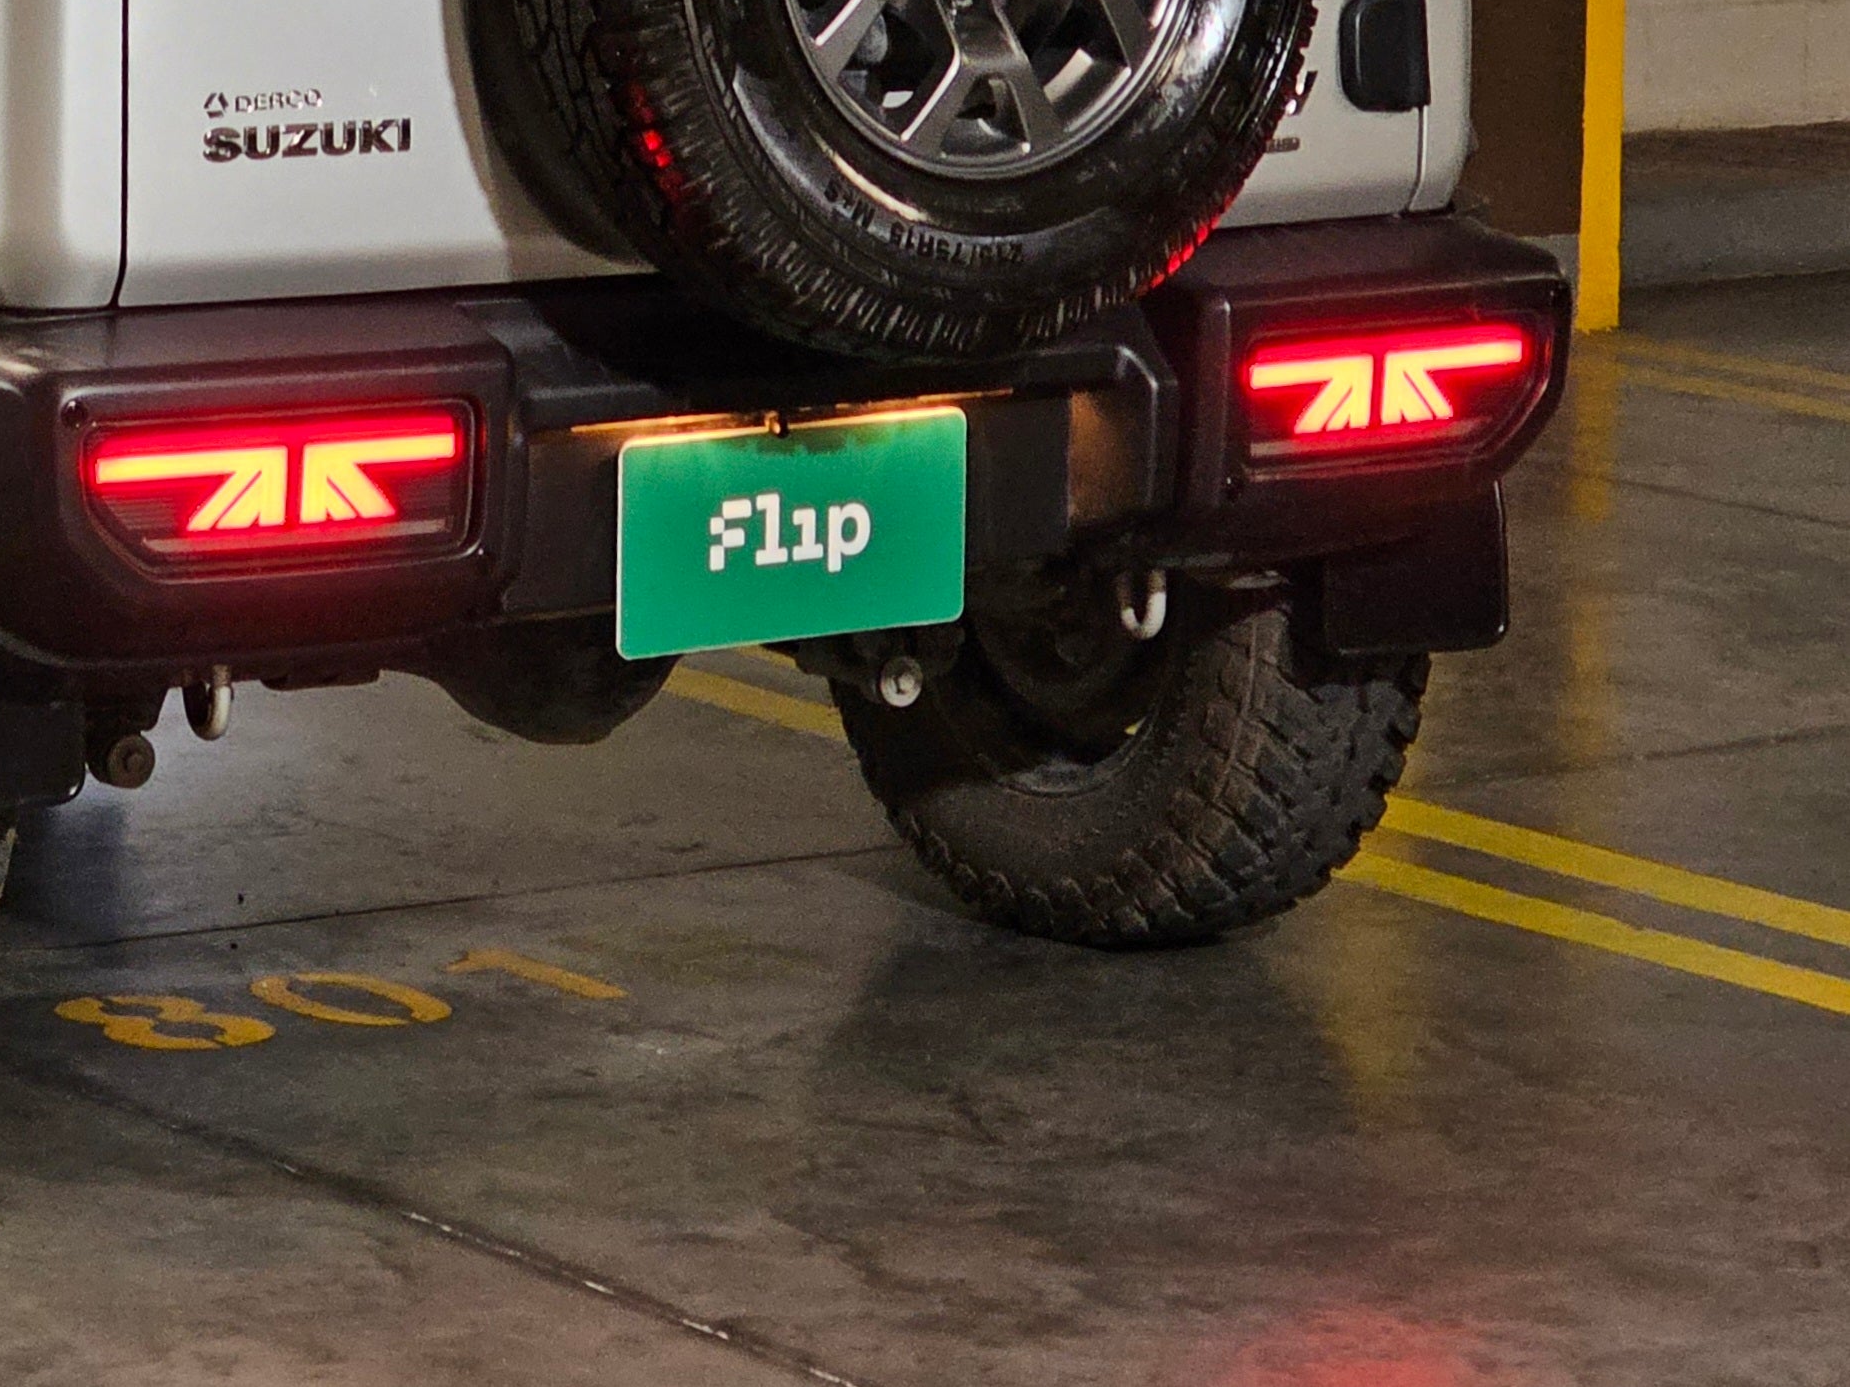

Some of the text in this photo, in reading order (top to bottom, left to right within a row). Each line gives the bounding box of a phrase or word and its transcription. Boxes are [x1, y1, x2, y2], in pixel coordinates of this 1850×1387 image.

[234, 87, 323, 114] DERCO
[203, 118, 411, 163] SUZUKI
[54, 948, 630, 1050] 801
